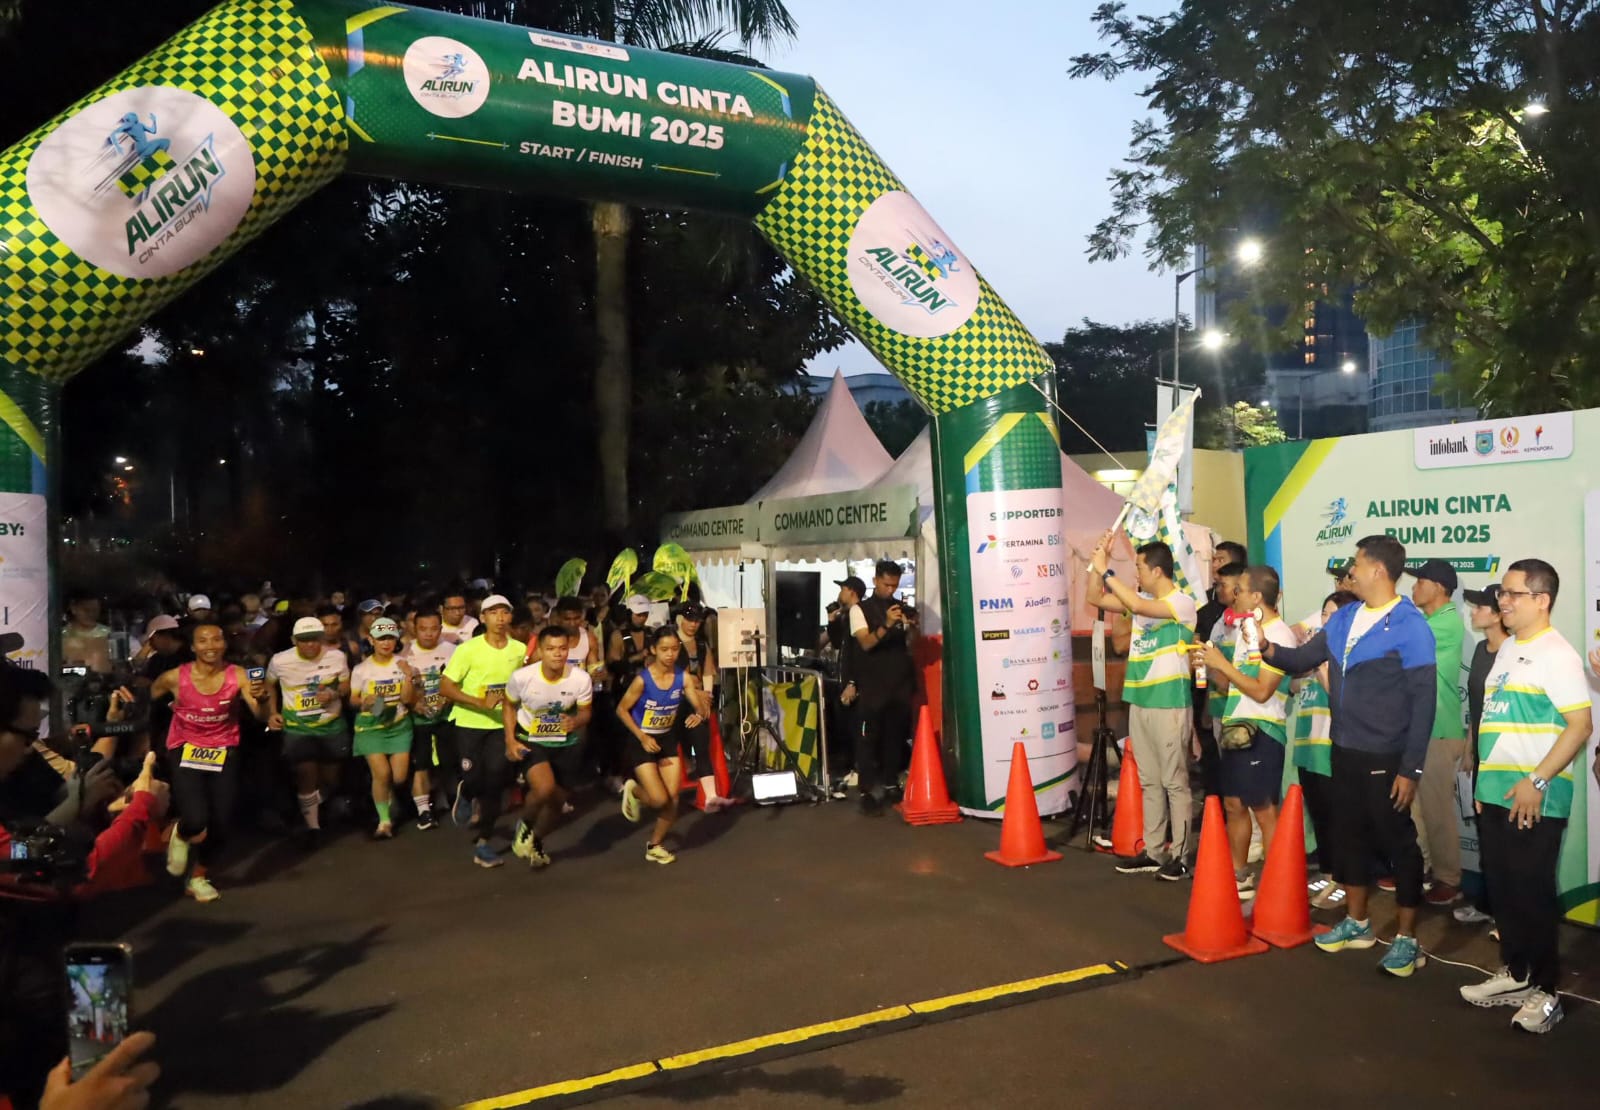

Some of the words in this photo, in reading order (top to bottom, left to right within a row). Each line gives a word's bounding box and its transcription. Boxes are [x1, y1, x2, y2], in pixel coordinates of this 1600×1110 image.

[420, 80, 474, 92] ALIRUN
[518, 58, 648, 100] ALIRUN
[656, 82, 754, 118] CINTA
[552, 100, 642, 138] BUMI
[650, 116, 725, 150] 2025
[519, 141, 575, 159] START
[575, 147, 586, 162] /
[588, 151, 644, 169] FINISH
[125, 147, 219, 257] ALIRUN
[138, 230, 175, 264] CINTA
[174, 201, 203, 233] BUMI
[858, 256, 886, 282] CINTA
[865, 246, 947, 311] ALIRUN
[1429, 435, 1469, 456] infobank
[989, 508, 1055, 521] SPPORTED
[1366, 497, 1439, 518] ALIRUN
[1445, 493, 1512, 515] CINTA
[774, 508, 834, 531] COMMAND
[836, 502, 888, 526] CENTRE
[671, 520, 710, 539] COMMAND
[711, 518, 744, 536] CENTRE
[1315, 525, 1353, 541] ALIRUN
[1385, 526, 1436, 545] BUMI
[1441, 524, 1491, 544] 2025
[1049, 563, 1065, 577] BNI
[979, 598, 1013, 610] PNM
[1025, 596, 1051, 608] Aladin
[537, 723, 561, 733] 10022
[191, 747, 222, 760] 10047
